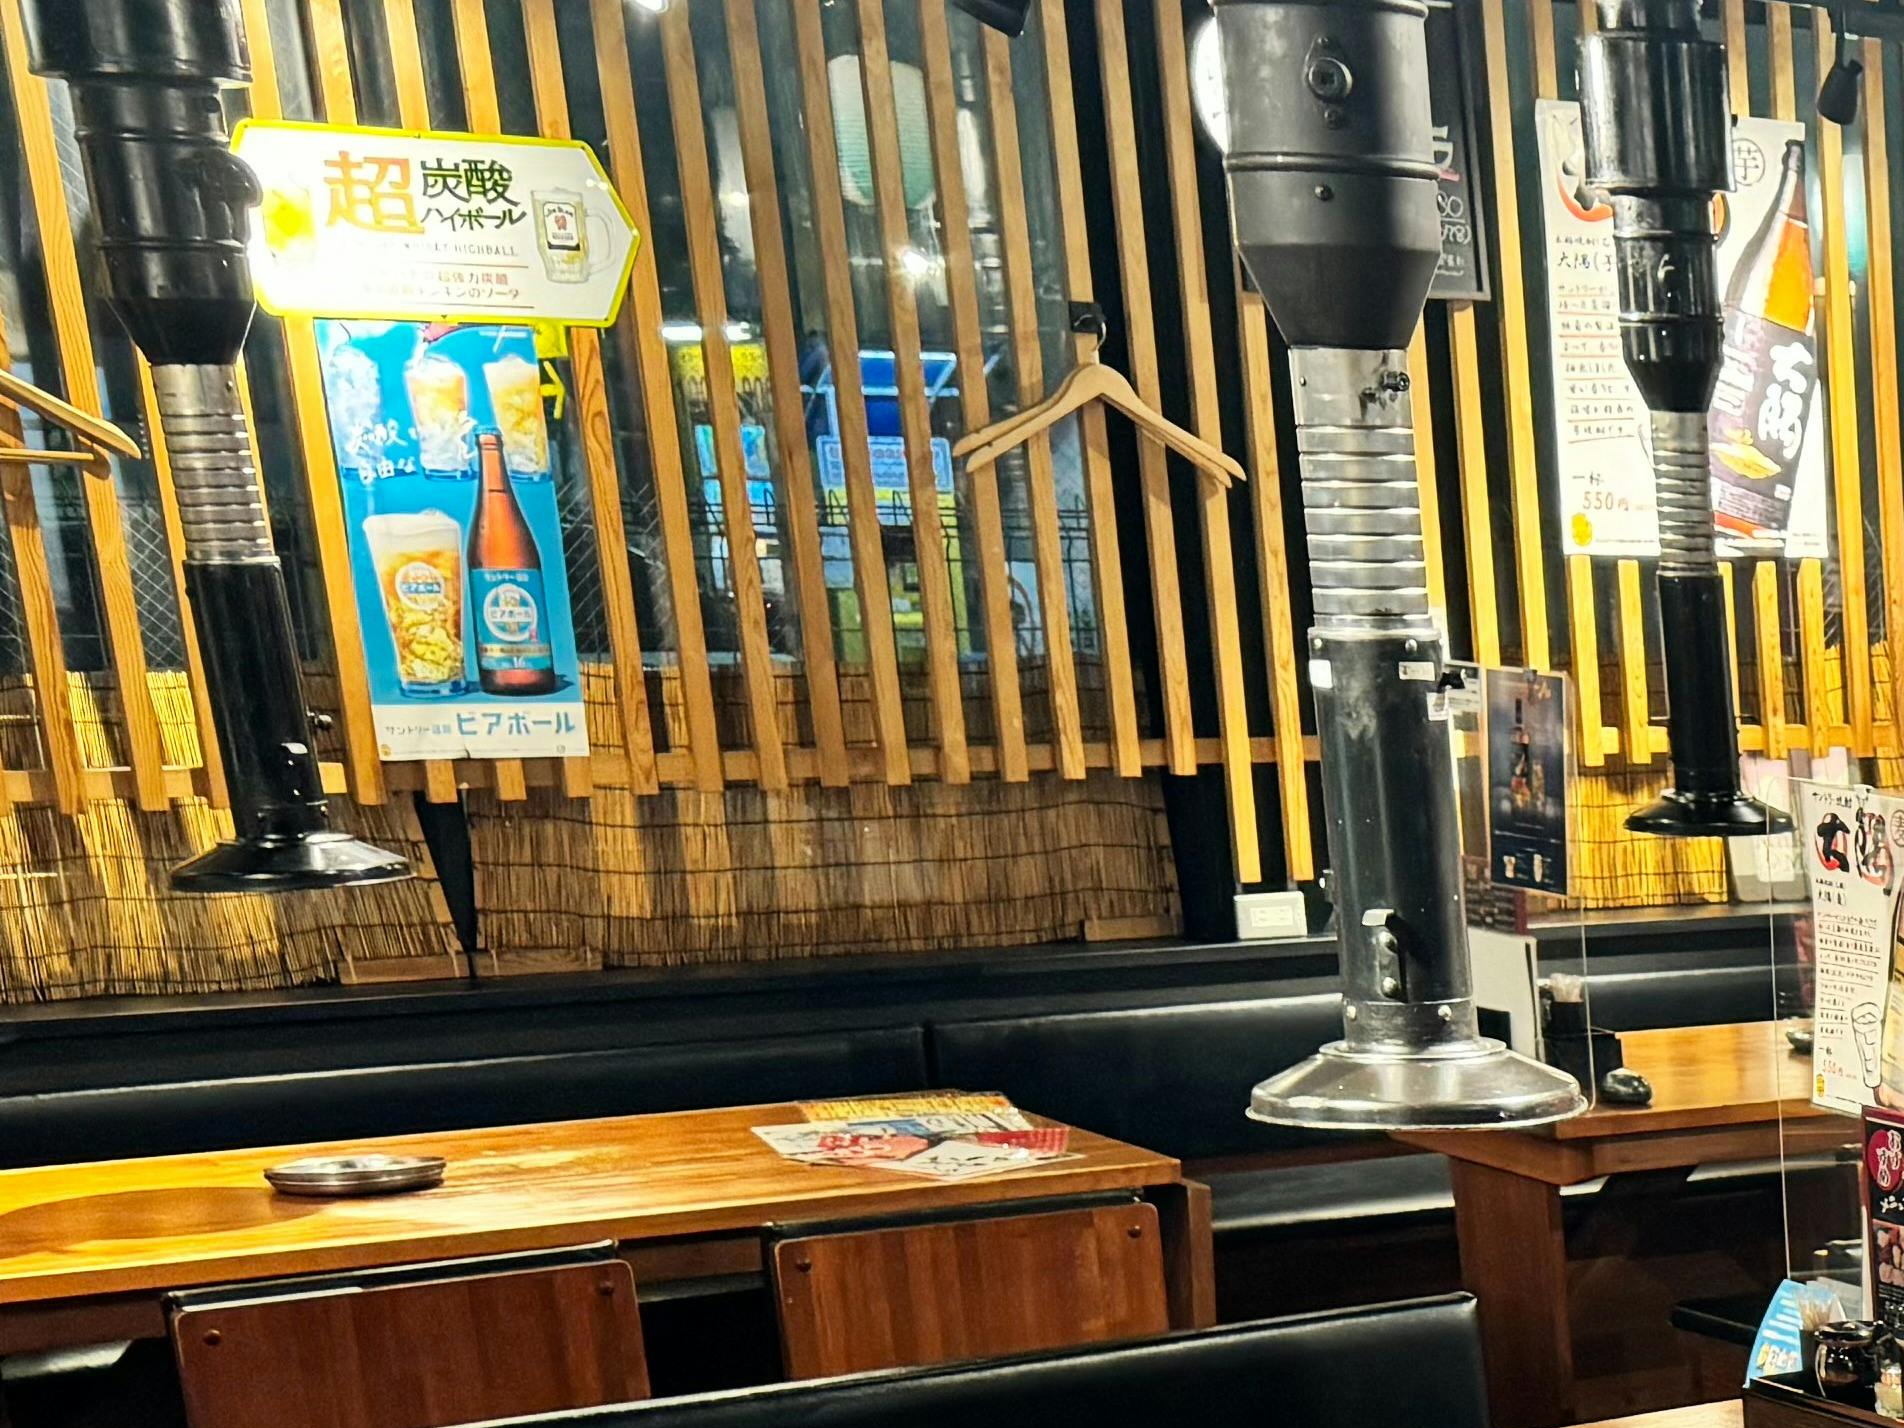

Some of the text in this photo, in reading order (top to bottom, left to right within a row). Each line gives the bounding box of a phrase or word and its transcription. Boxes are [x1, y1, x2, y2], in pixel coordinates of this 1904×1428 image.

[323, 150, 520, 235] 超 炭酸
[421, 207, 527, 233] ハイボール
[456, 713, 576, 737] ビアボール
[1814, 806, 1895, 897] 大隅
